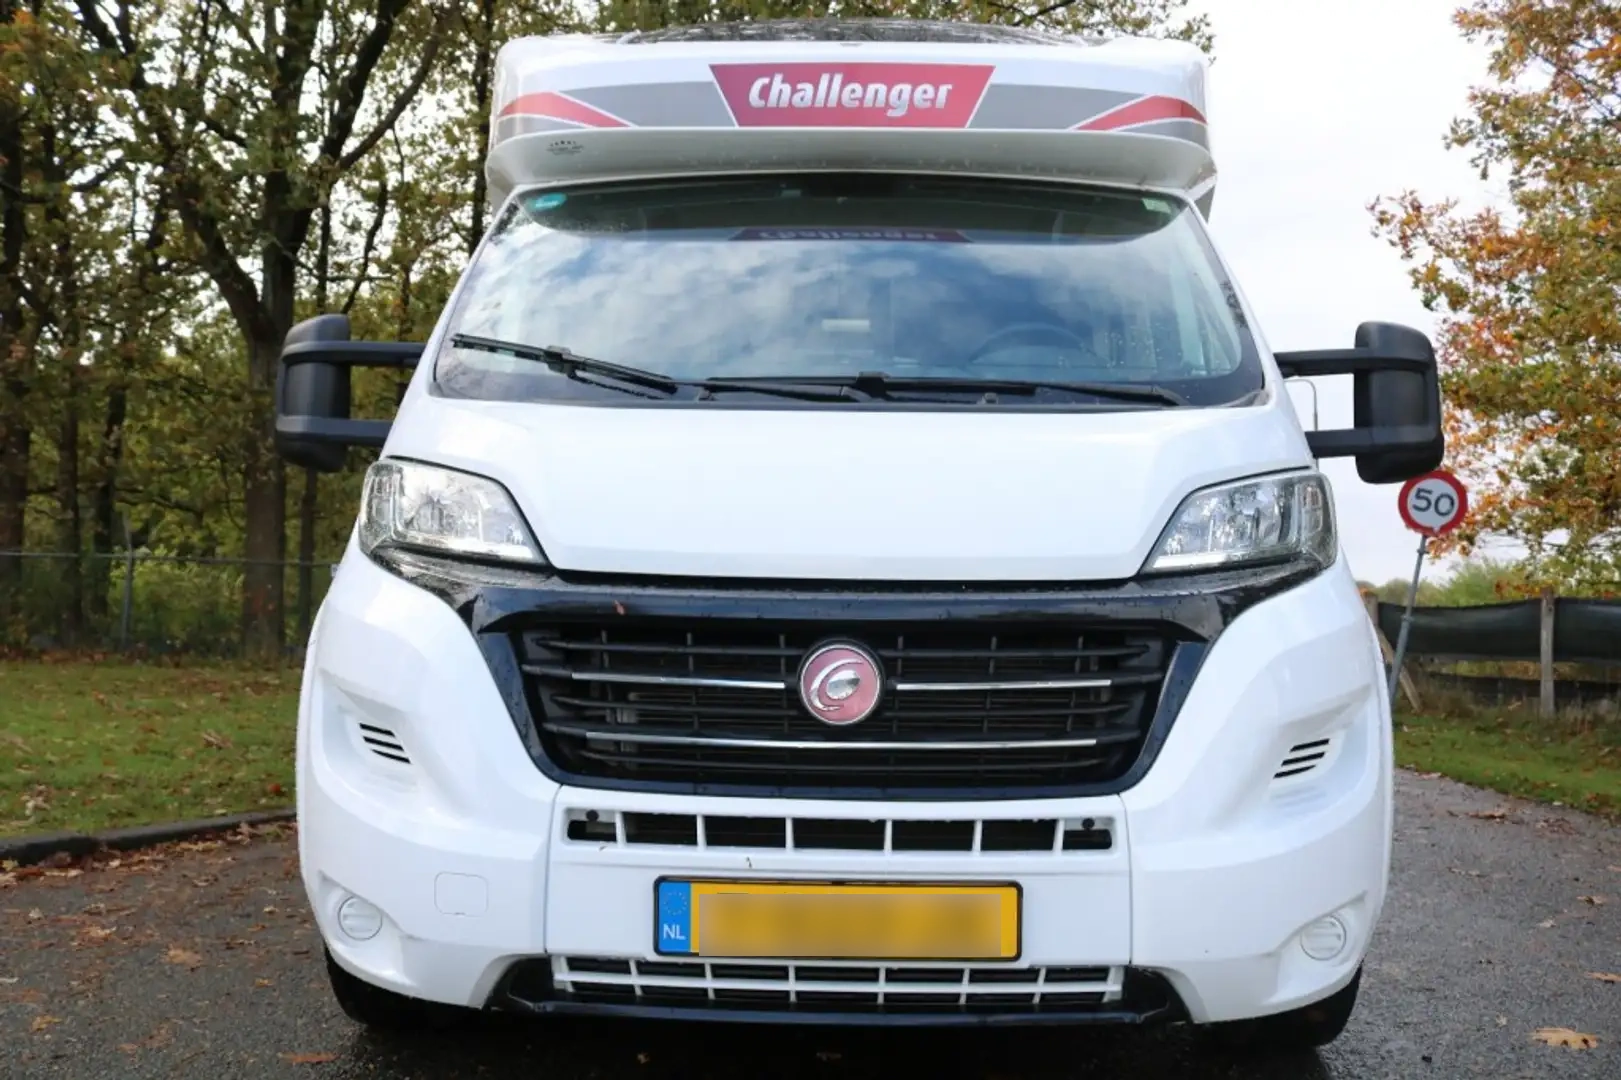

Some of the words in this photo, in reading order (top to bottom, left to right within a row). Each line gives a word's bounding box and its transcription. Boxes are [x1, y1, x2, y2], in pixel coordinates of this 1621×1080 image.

[748, 73, 953, 117] Challenger
[1412, 488, 1455, 517] 50
[663, 923, 686, 940] NL
